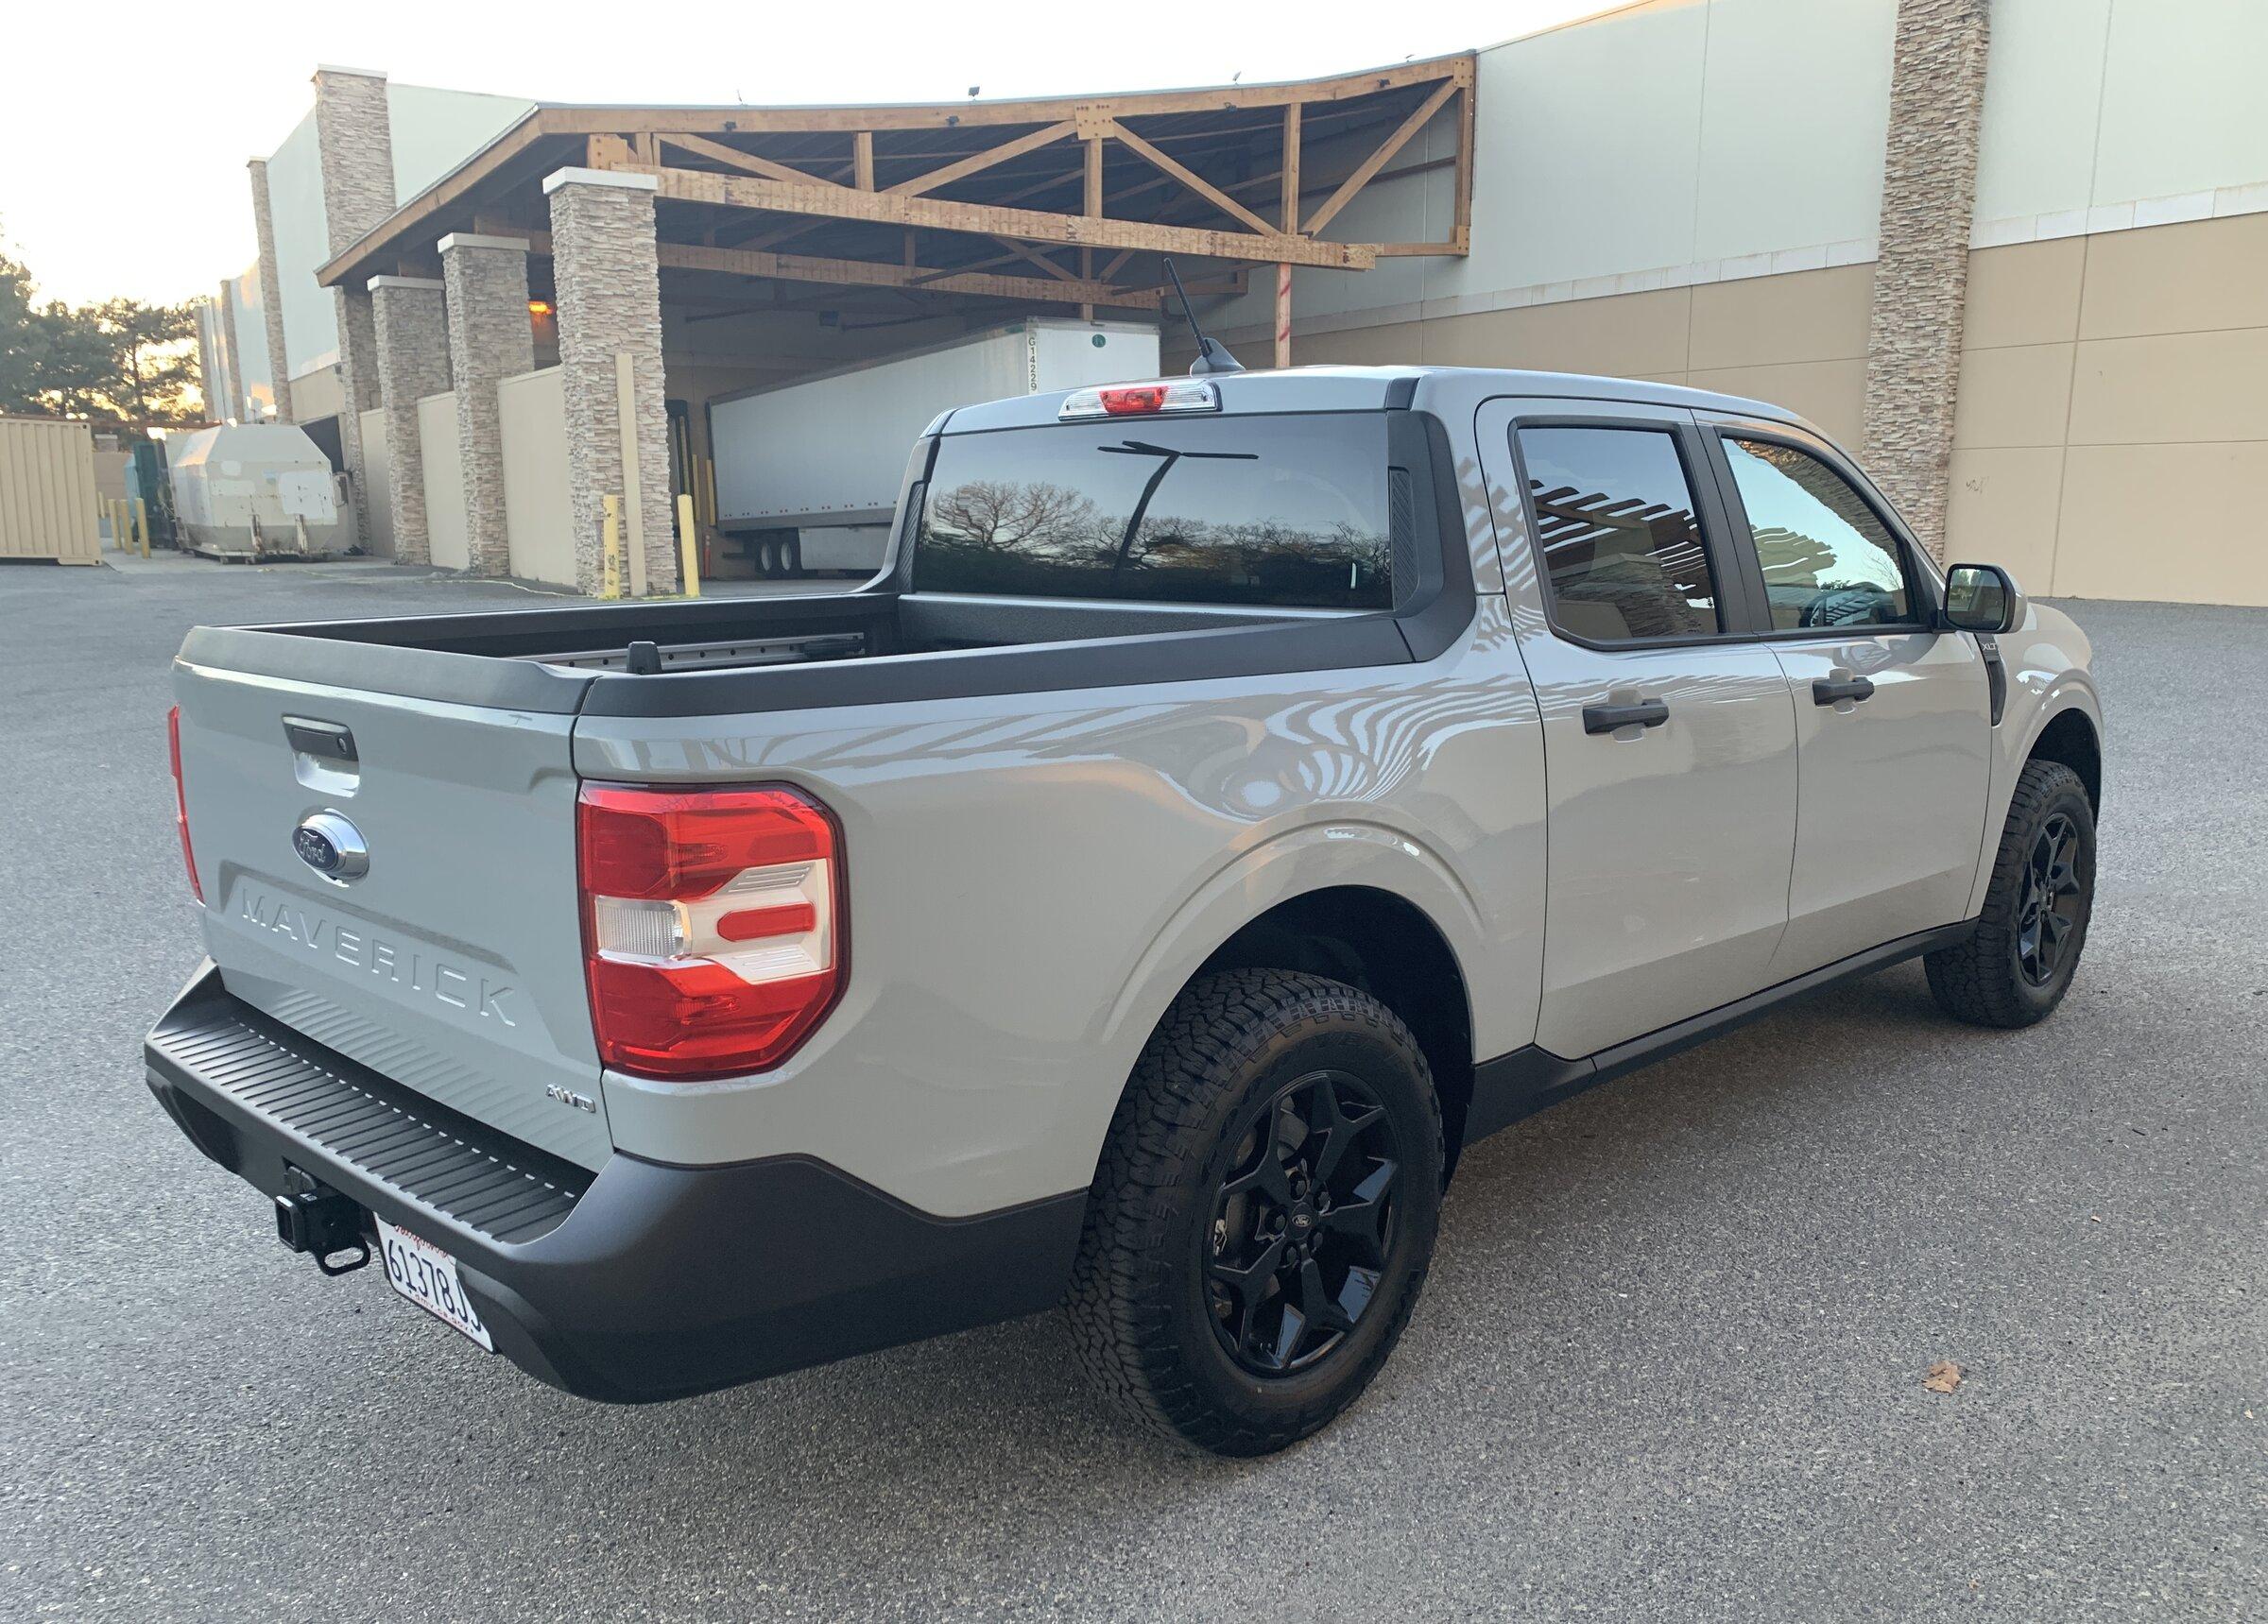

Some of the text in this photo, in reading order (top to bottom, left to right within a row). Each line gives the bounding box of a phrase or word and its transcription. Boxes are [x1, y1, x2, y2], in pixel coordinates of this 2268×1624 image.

[1028, 336, 1038, 391] G14229
[1981, 642, 1996, 651] XLT
[298, 829, 327, 863] Ford
[243, 888, 515, 1027] MAVERICK
